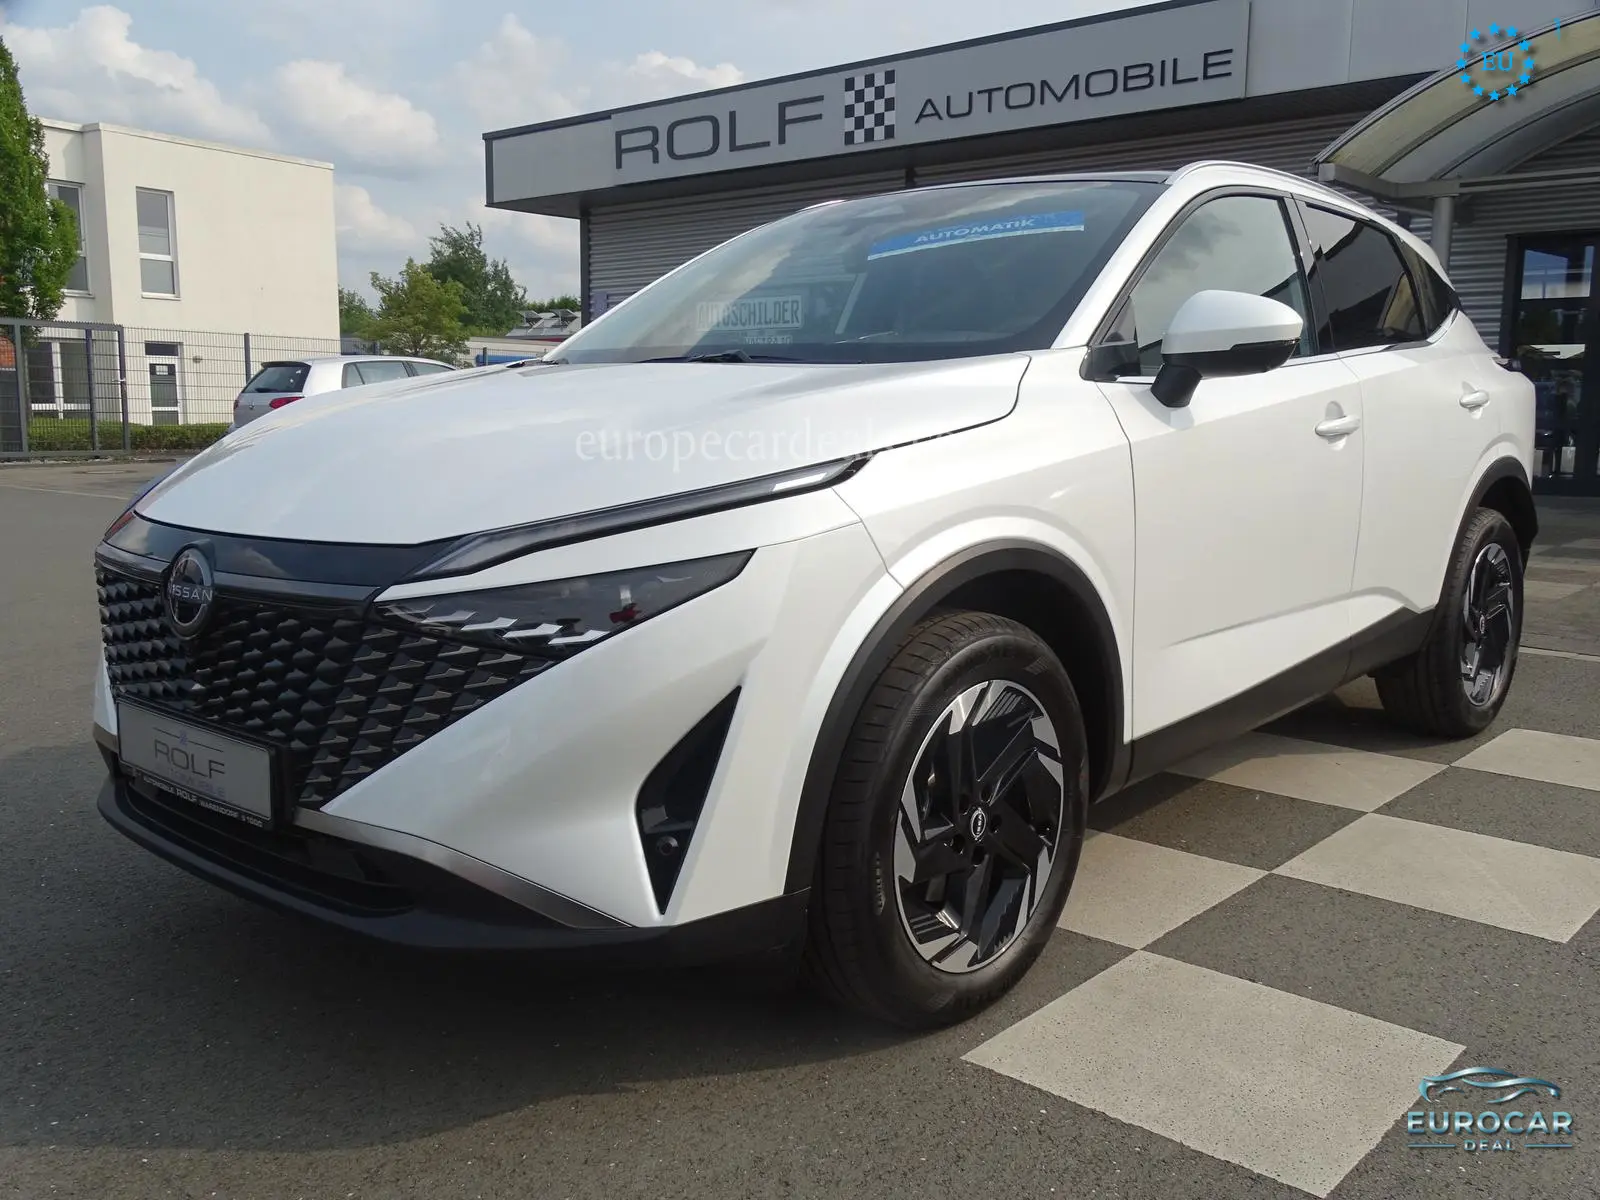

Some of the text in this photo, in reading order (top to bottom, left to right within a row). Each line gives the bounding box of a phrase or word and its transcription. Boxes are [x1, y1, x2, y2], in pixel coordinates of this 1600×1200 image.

[615, 48, 1234, 170] ROLF AUTOMOBILE
[913, 217, 1036, 244] AUTOMATIK
[154, 739, 226, 779] ROLF
